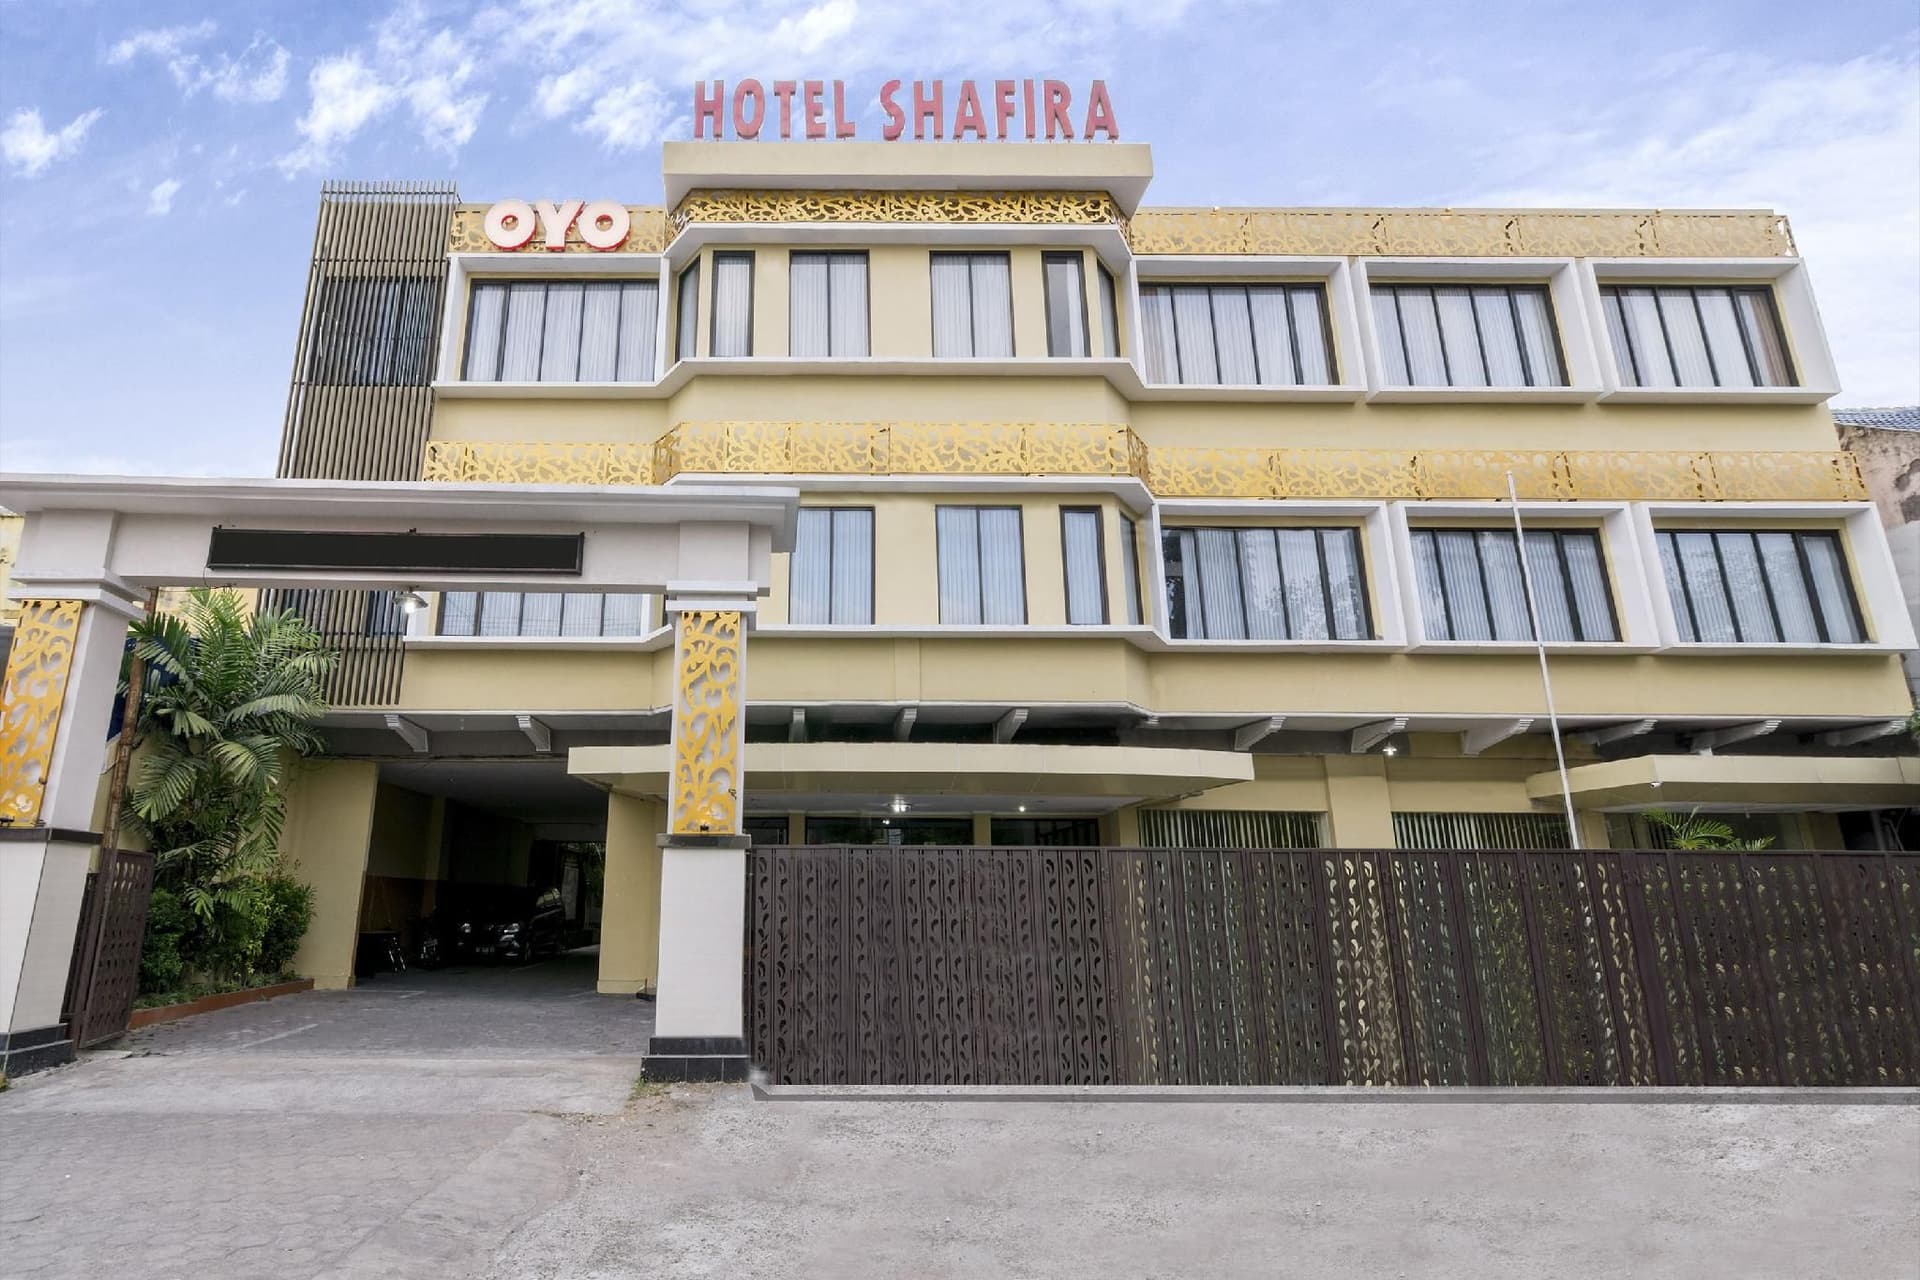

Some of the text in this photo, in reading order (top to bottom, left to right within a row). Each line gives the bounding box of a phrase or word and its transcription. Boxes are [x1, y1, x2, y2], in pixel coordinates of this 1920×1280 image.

[694, 79, 1119, 141] HOTEL SHAFIRA
[484, 200, 631, 250] OYO
